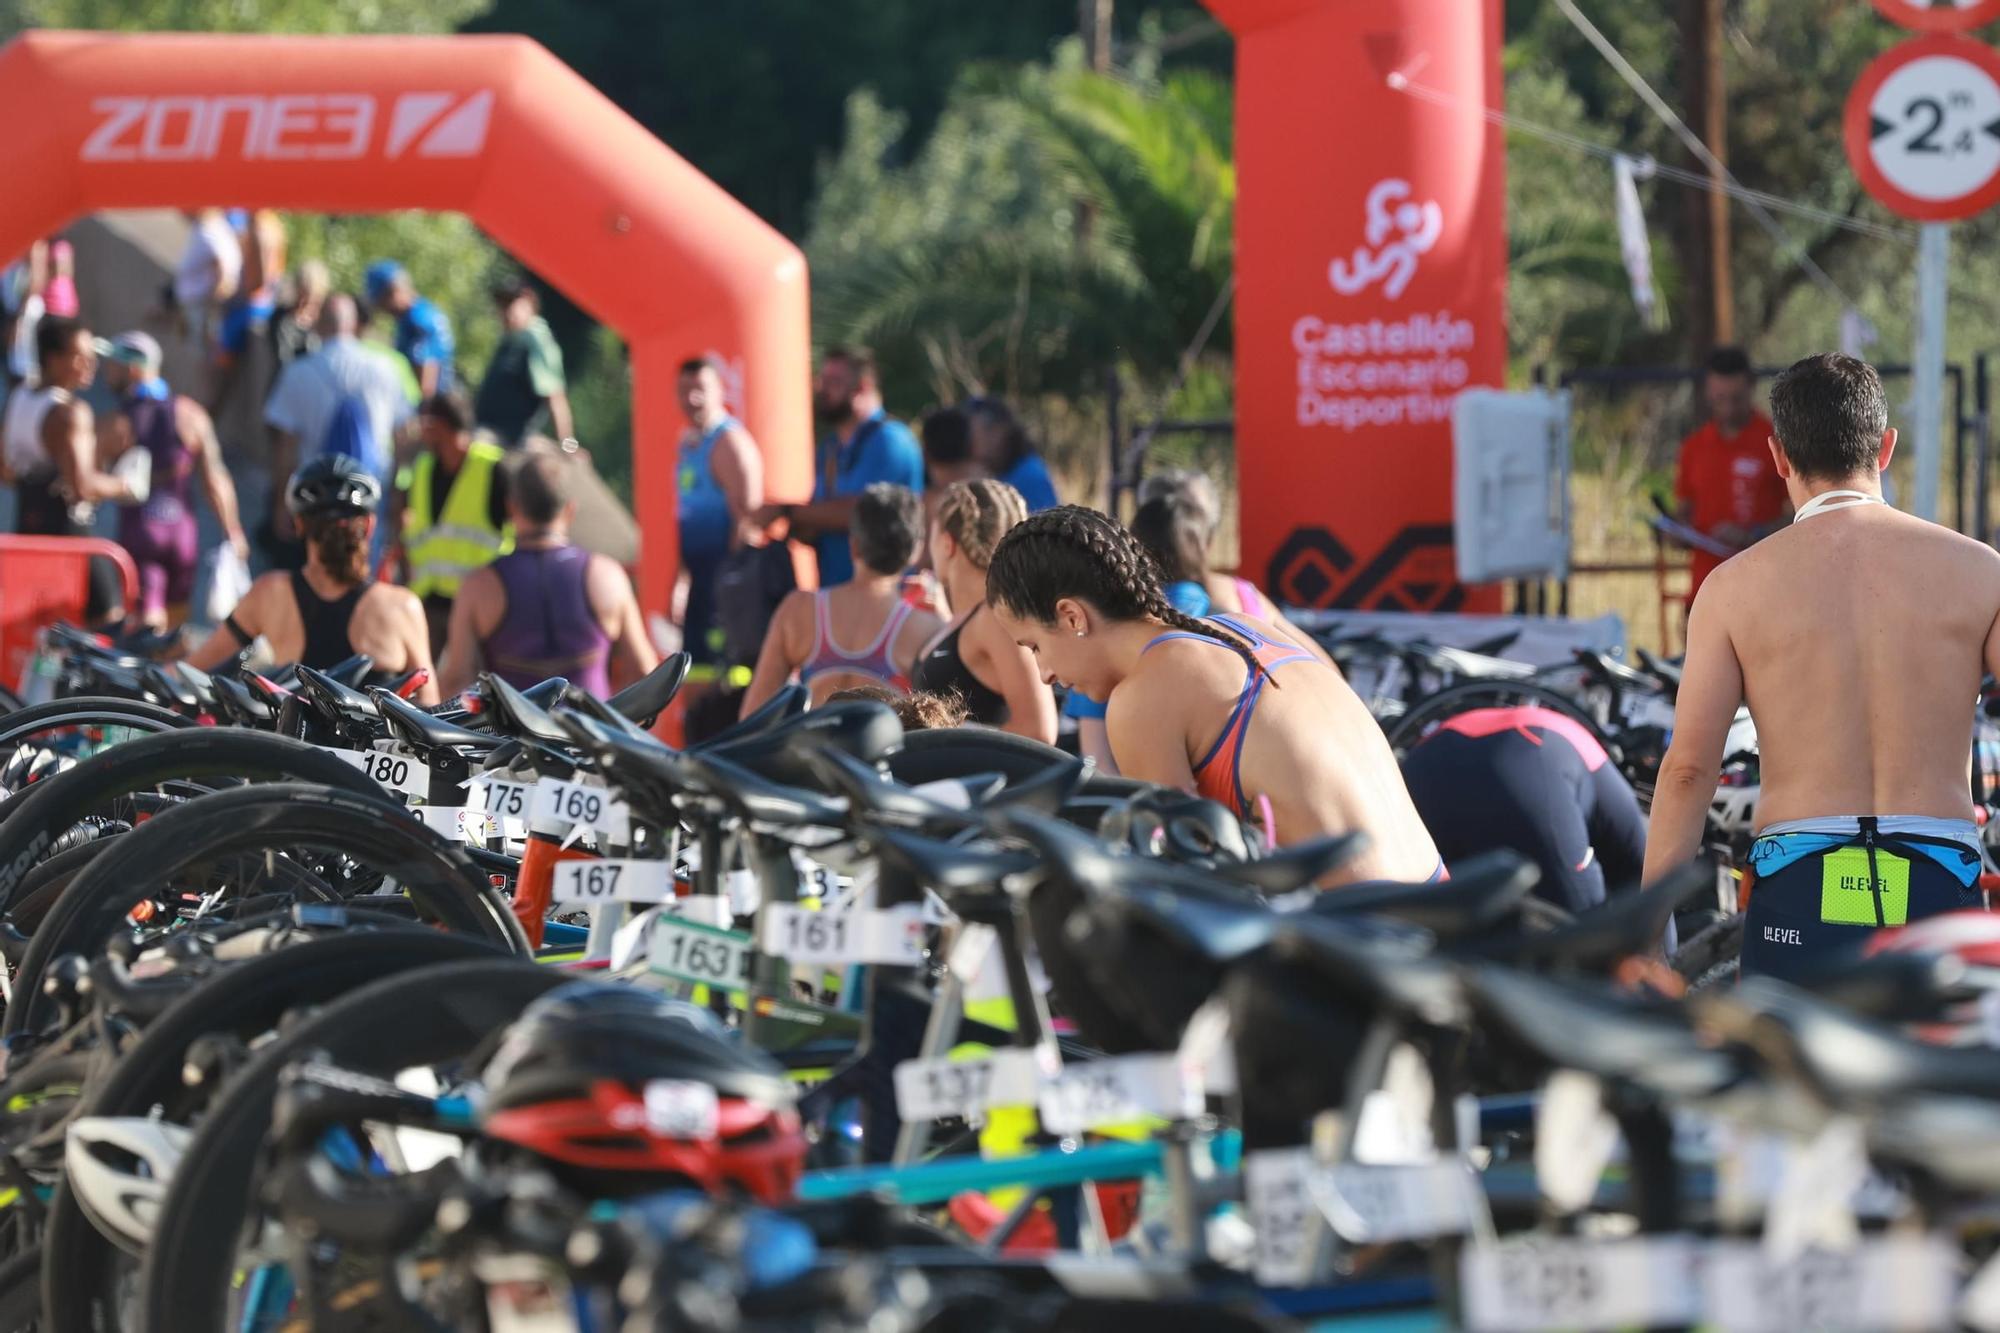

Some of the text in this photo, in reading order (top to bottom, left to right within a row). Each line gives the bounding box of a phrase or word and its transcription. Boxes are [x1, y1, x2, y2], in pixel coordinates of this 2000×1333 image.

[80, 95, 377, 161] ZONE3
[1292, 309, 1474, 355] Castellón
[1298, 357, 1468, 391] Escenario
[1297, 393, 1459, 430] Deportiv
[364, 754, 408, 786] 180
[484, 783, 524, 815] 175
[552, 786, 601, 823] 169
[571, 865, 622, 896] 167
[786, 916, 845, 950] 161
[1763, 926, 1803, 945] ULEVEL
[671, 934, 731, 978] 163
